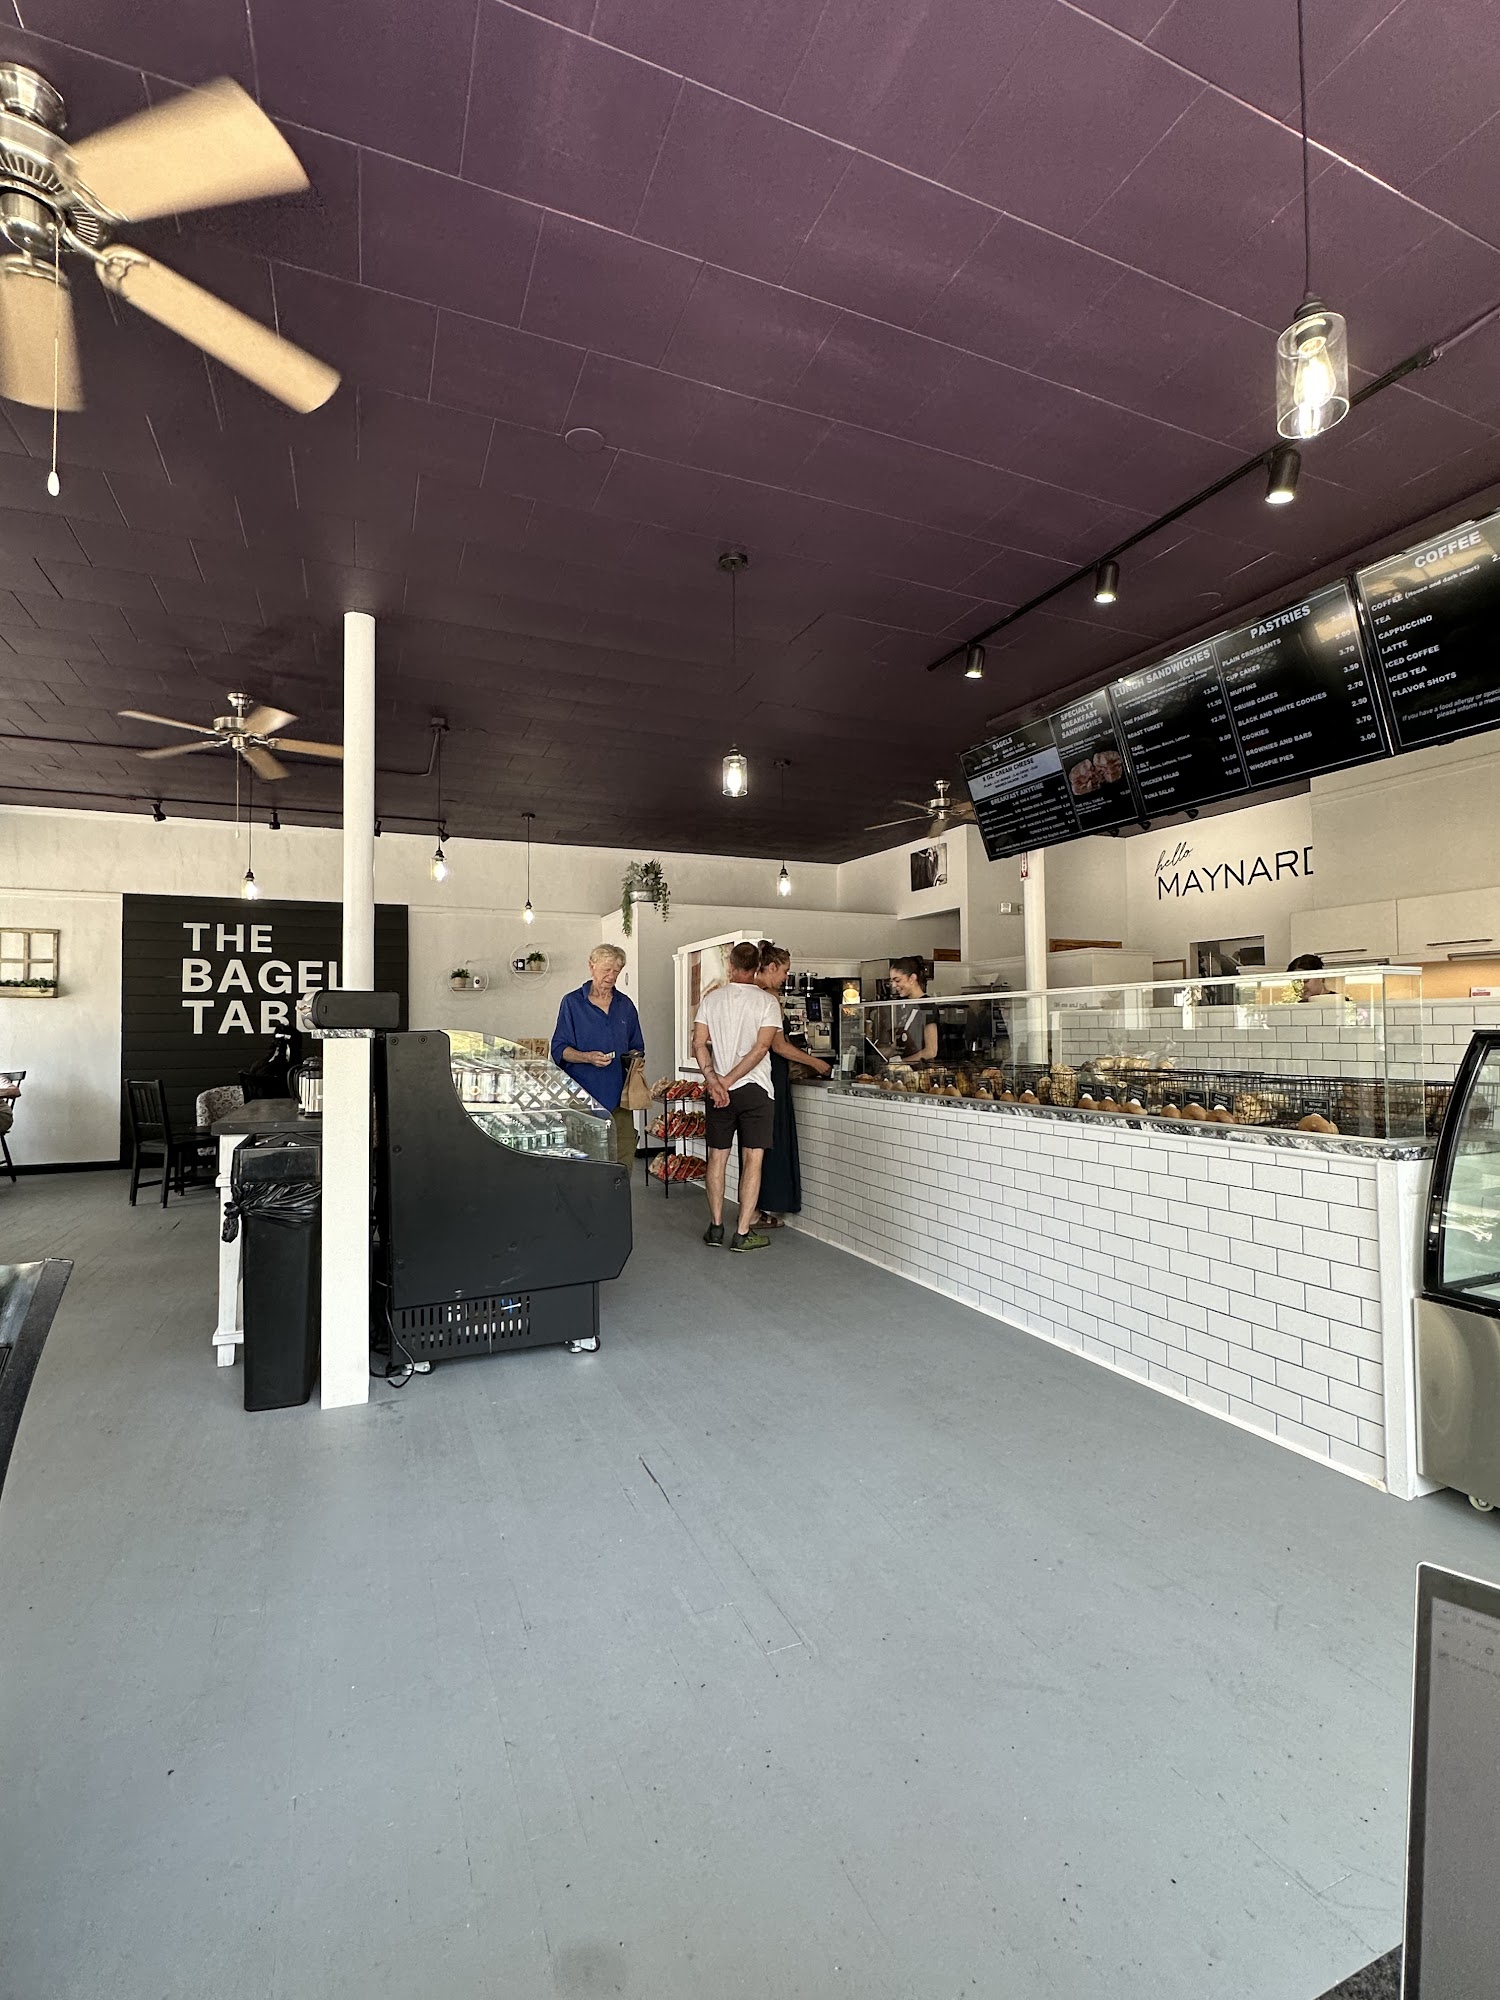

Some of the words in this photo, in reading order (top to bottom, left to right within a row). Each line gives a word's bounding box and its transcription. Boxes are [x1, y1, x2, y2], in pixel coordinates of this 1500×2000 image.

[1414, 530, 1481, 569] COFFEE
[1371, 593, 1403, 612] COFFEE
[1429, 580, 1441, 588] and
[1250, 604, 1310, 638] PASTRIES
[1374, 614, 1391, 625] TEA
[1378, 614, 1433, 640] CAPPUCCINO
[1222, 655, 1239, 666] PLAIN
[1241, 638, 1281, 658] CROISSANTS
[1381, 639, 1408, 654] LATTE
[1385, 657, 1405, 669] ICED
[1406, 644, 1440, 661] COFFEE
[1114, 678, 1143, 696] LUNCH
[1146, 649, 1210, 683] SANDWICHES
[1226, 672, 1238, 681] CUP
[1240, 664, 1259, 675] CAKES
[1230, 682, 1256, 696] MUFFINS
[1339, 645, 1354, 655] 3.70
[1388, 672, 1408, 683] ICED
[1409, 665, 1427, 676] TEA
[1392, 682, 1425, 697] FLAVOR
[1427, 671, 1457, 686] SHOTS
[1060, 701, 1094, 720] SPECIALTY
[1234, 700, 1255, 711] CRUMB
[1257, 691, 1277, 702] CAKES
[1238, 715, 1258, 726] BLACK
[1259, 710, 1272, 719] AND
[1274, 703, 1294, 713] WHITE
[1296, 691, 1326, 706] COOKIES
[1347, 680, 1363, 690] 2.70
[1419, 708, 1433, 717] have
[1061, 709, 1097, 729] BREAKFAST
[1061, 716, 1102, 738] SANDWICHES
[1127, 729, 1142, 738] ROAST
[1144, 721, 1163, 732] TURKEY
[992, 737, 1012, 750] BAGELS
[1242, 728, 1268, 740] COOKIES
[1245, 742, 1277, 755] BROWNIES
[1278, 737, 1292, 745] AND
[1294, 731, 1311, 740] BARS
[1356, 715, 1371, 724] 3.70
[1250, 758, 1278, 770] WHOOPIE
[1279, 753, 1294, 762] PIES
[1360, 733, 1375, 741] 3.00
[995, 766, 1012, 776] CREAM
[1013, 757, 1033, 769] CHEESE
[1140, 776, 1162, 786] CHICKEN
[1163, 771, 1179, 780] SALAD
[990, 791, 1018, 805] BREAKFAST
[1020, 782, 1043, 795] ANYTIME
[1144, 791, 1158, 799] TUNA
[1158, 787, 1174, 795] SALAD
[1154, 841, 1193, 877] hello
[182, 922, 273, 954] THE
[181, 957, 344, 994] BAGEL
